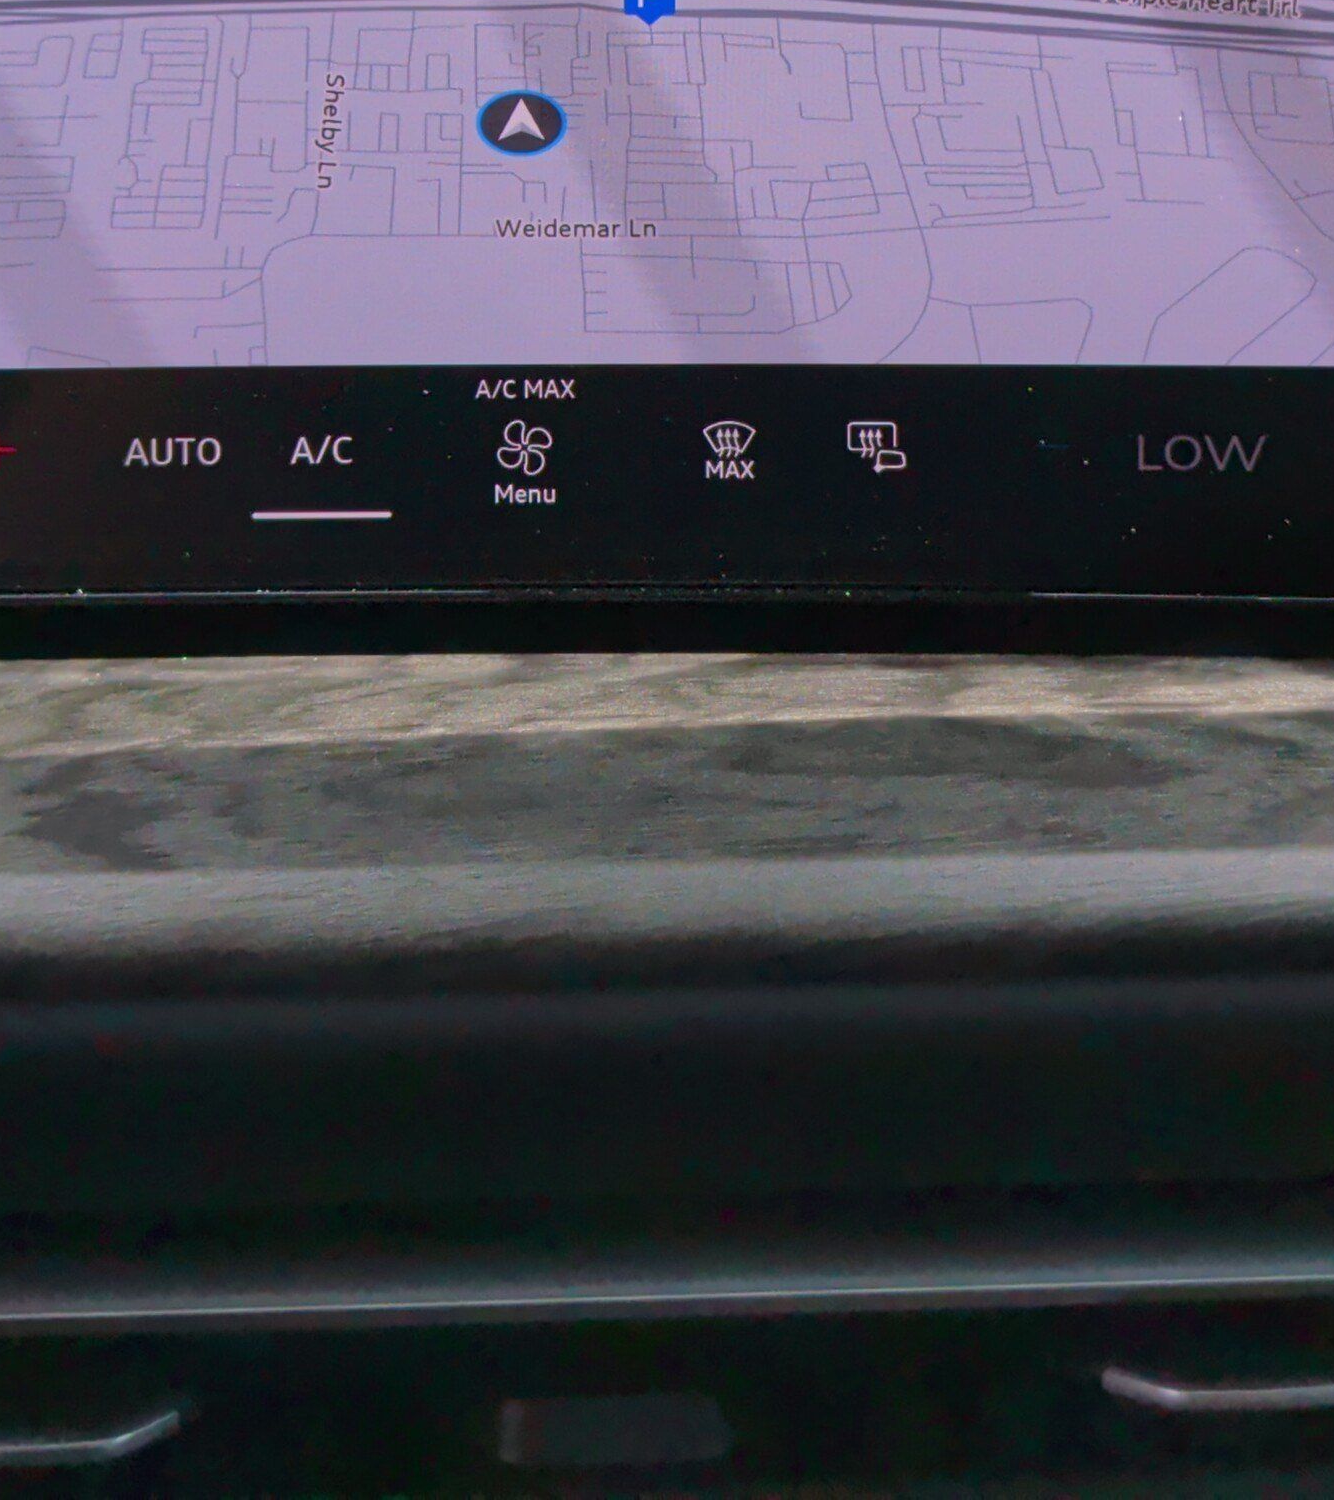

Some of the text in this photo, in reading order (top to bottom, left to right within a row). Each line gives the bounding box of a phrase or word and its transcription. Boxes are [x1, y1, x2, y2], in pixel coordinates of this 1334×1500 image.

[315, 74, 345, 189] Shelby Ln
[496, 219, 657, 239] Weidemar Ln
[475, 380, 575, 399] A/C MAX
[124, 438, 222, 467] AUTO
[290, 435, 353, 466] A/C
[1137, 434, 1267, 472] LOW
[705, 461, 755, 479] MAX
[494, 484, 556, 504] Menu
